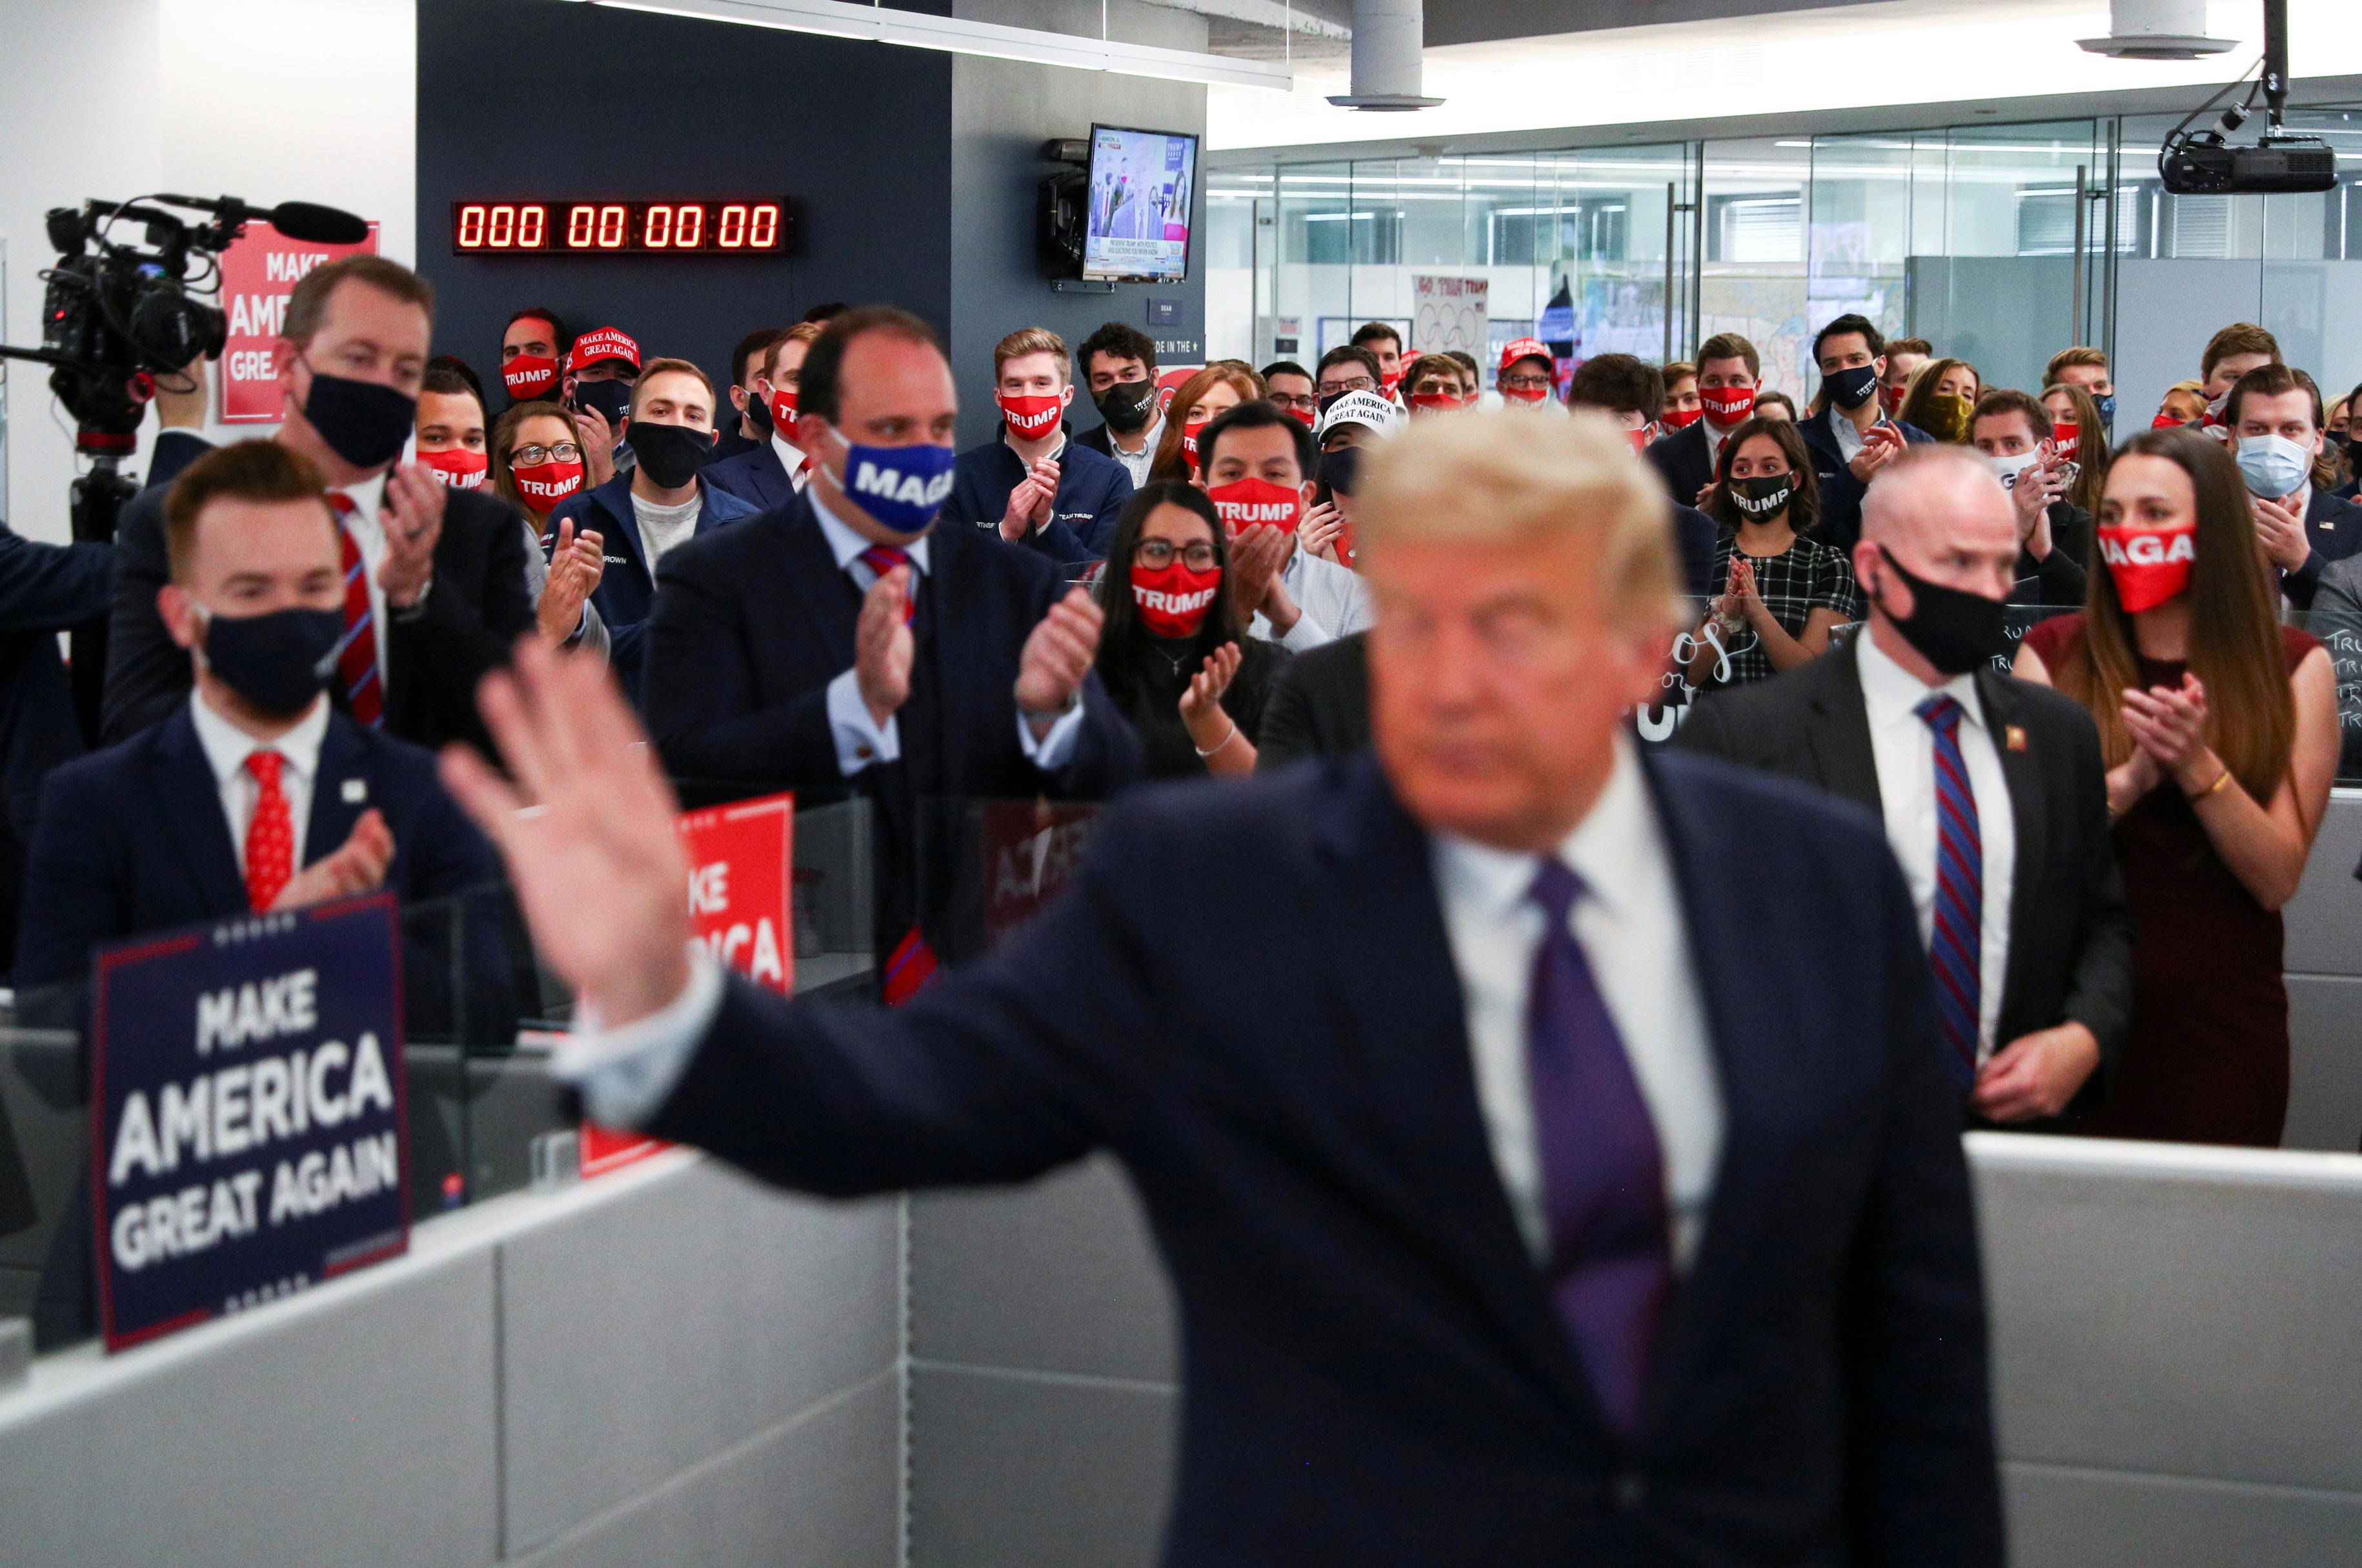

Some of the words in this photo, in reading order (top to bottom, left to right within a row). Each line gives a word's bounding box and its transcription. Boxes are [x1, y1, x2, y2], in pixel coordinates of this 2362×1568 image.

[459, 206, 544, 247] 000
[568, 206, 624, 247] 00
[645, 206, 703, 247] 00
[718, 206, 778, 247] 00
[267, 252, 329, 281] MAK
[580, 333, 603, 346] MAKE
[605, 332, 637, 352] AMERICA
[585, 343, 611, 357] GREAT
[612, 345, 634, 362] AGAIN
[1167, 340, 1175, 353] IN
[1176, 340, 1190, 353] THE
[505, 368, 551, 386] TRUMP
[1134, 394, 1153, 409] TRUMP
[1329, 397, 1350, 414] MAKE
[1351, 397, 1391, 414] AMERICA
[1704, 397, 1751, 414] TRUMP
[1005, 406, 1057, 430] TRUMP
[1330, 409, 1356, 424] GREAT
[1357, 409, 1386, 425] AGAIN
[432, 468, 485, 489] RUMP
[521, 475, 580, 497] TRUMP
[1731, 488, 1788, 512] TRUMP
[1214, 501, 1294, 521] TRUMP
[1132, 584, 1216, 614] TRUMP
[196, 968, 319, 1057] MAKE
[108, 1031, 394, 1187] AMERICA
[111, 1169, 263, 1272] GREAT
[268, 1130, 399, 1226] AGAIN
